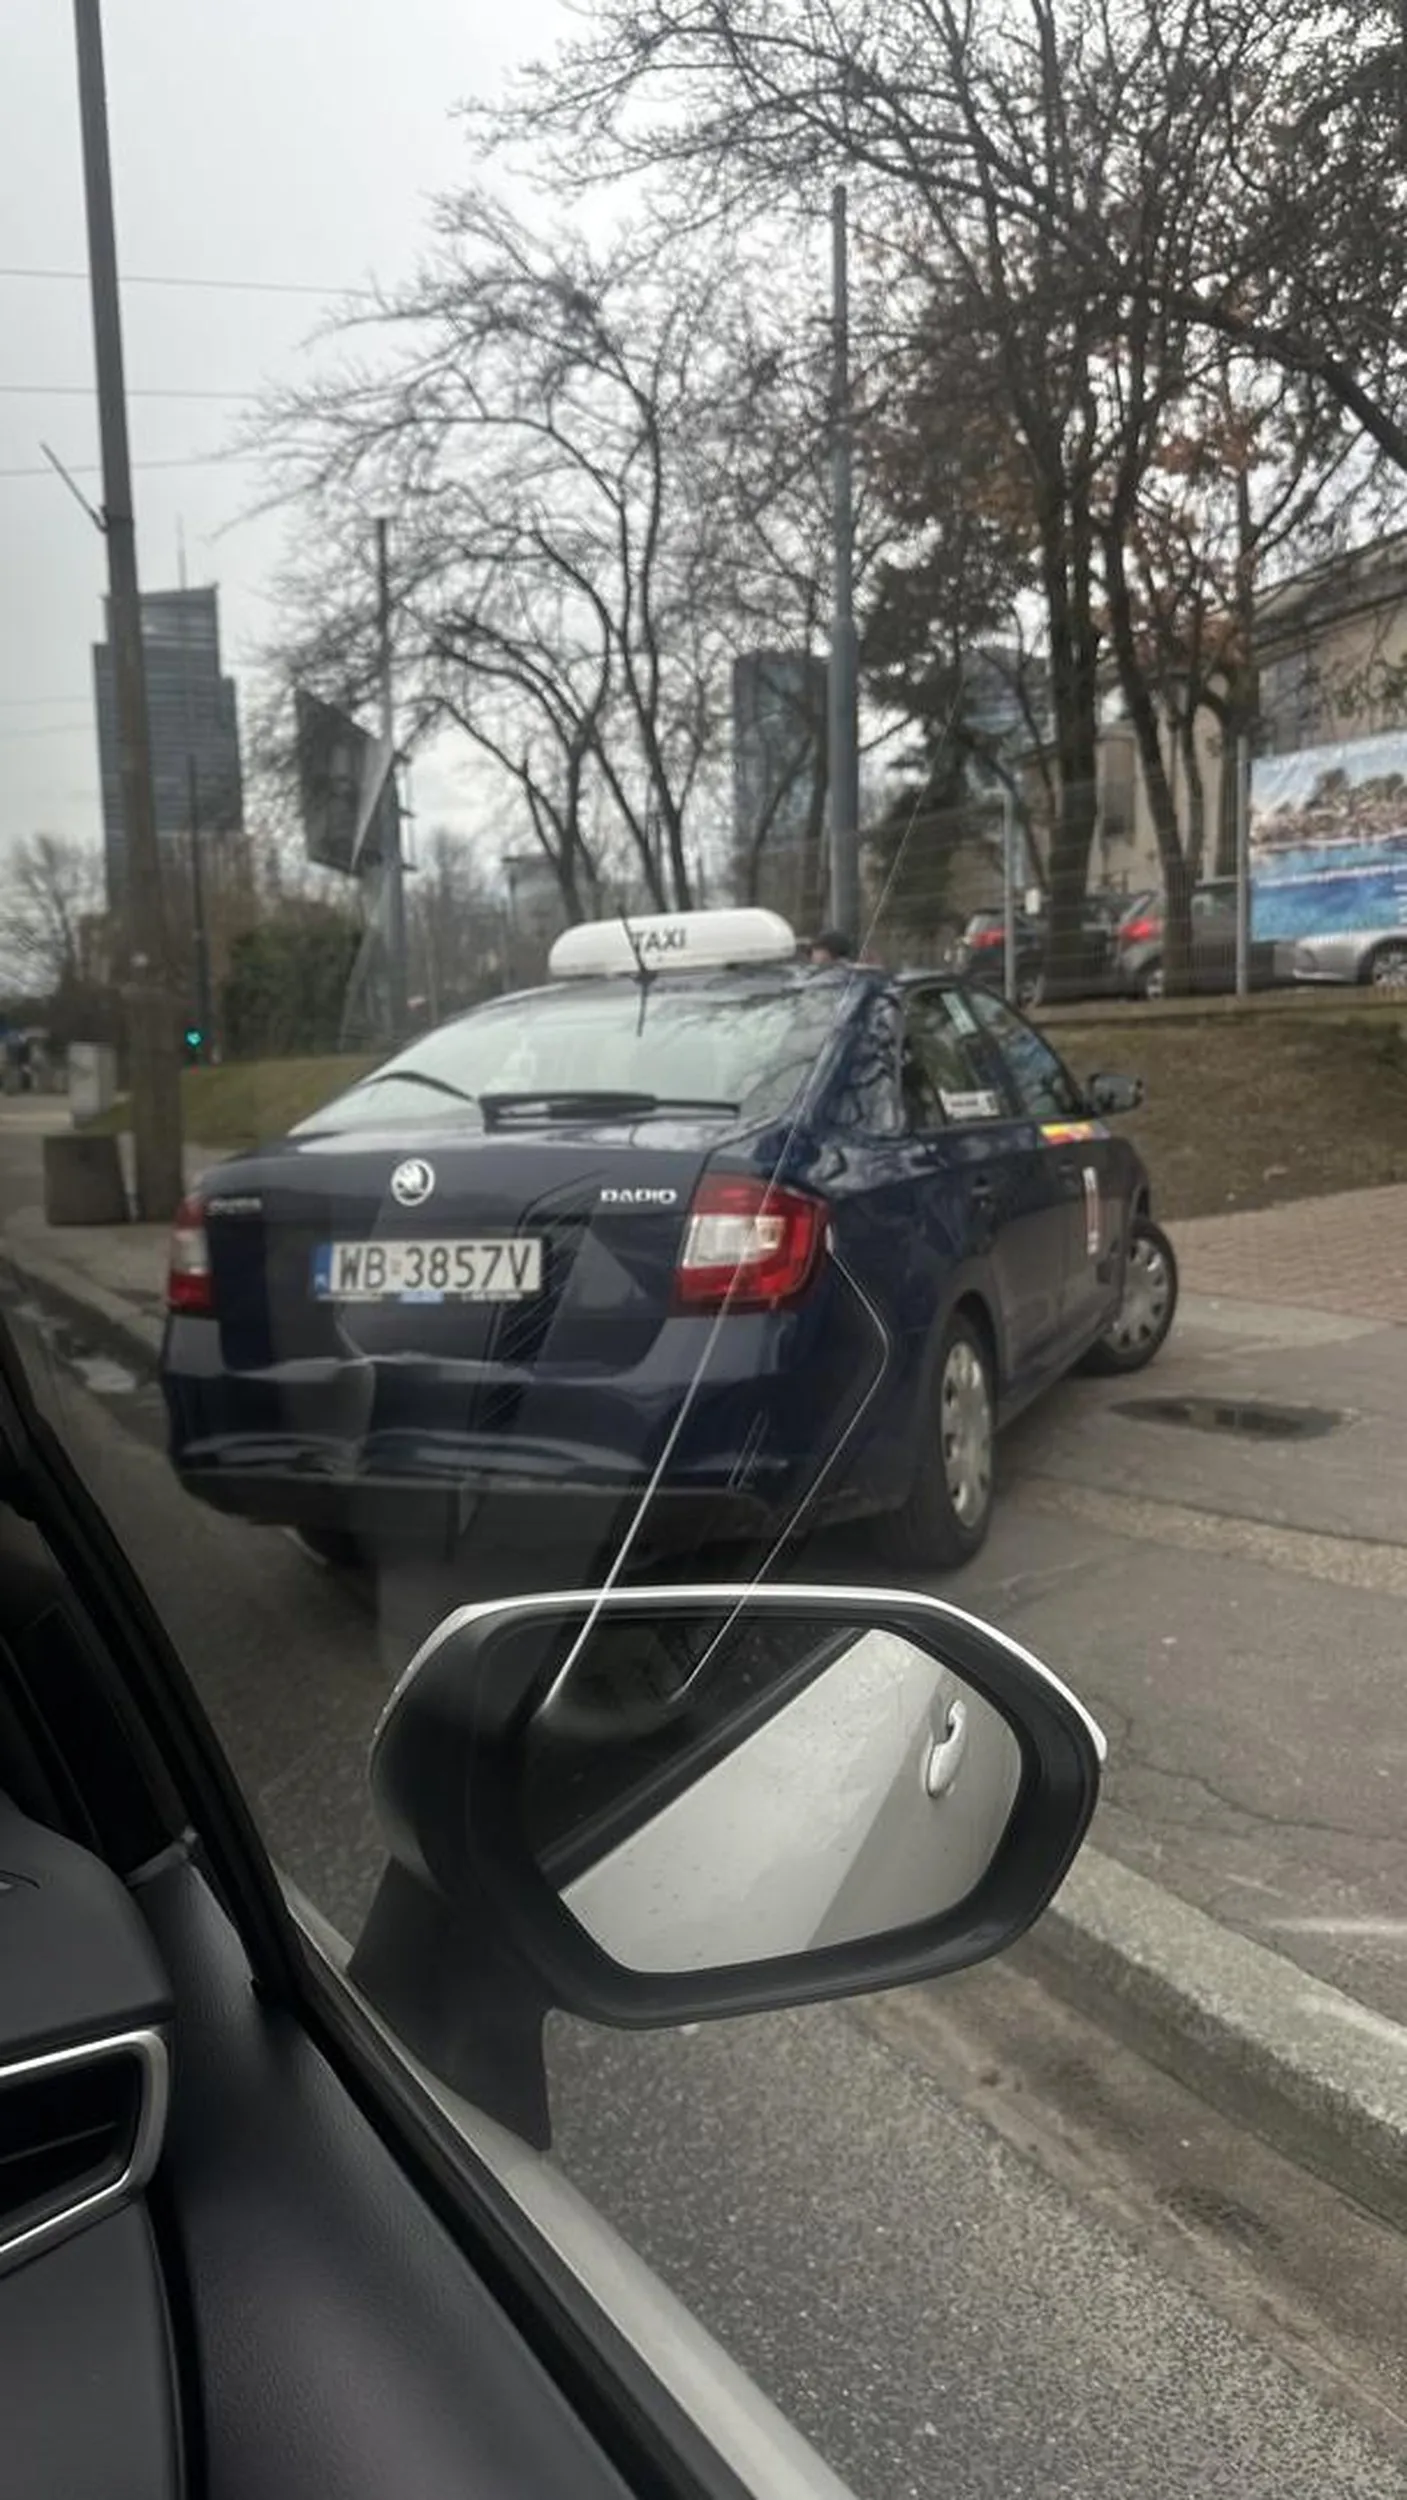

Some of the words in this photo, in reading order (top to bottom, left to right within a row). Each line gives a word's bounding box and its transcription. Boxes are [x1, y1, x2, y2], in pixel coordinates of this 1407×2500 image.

[629, 928, 686, 952] TAXI
[339, 1246, 387, 1289] WB
[404, 1245, 531, 1289] 3857V
